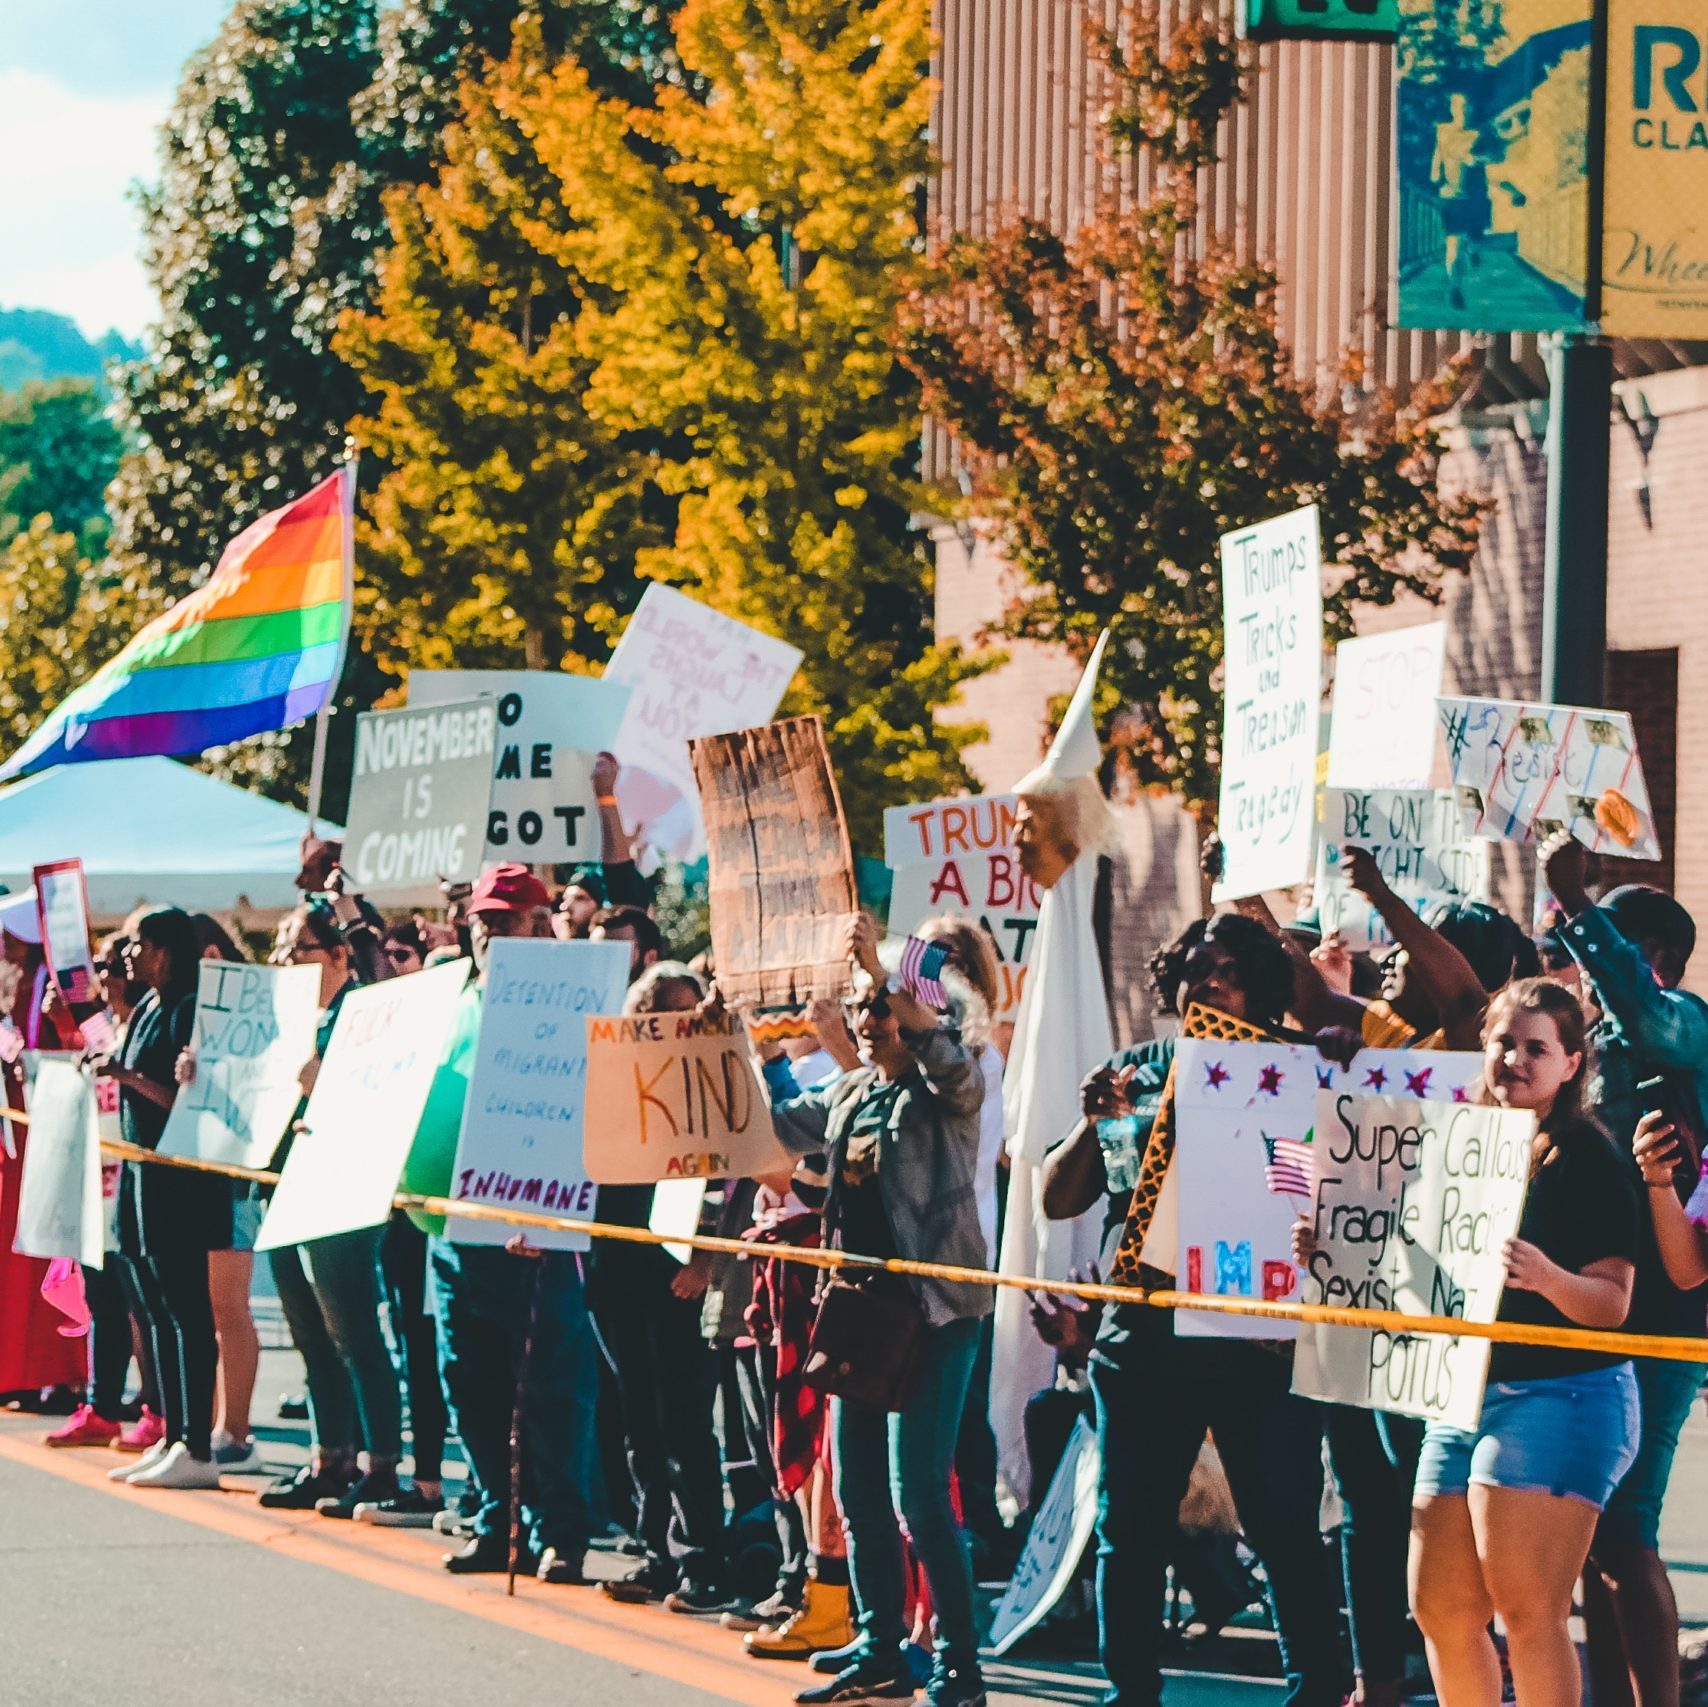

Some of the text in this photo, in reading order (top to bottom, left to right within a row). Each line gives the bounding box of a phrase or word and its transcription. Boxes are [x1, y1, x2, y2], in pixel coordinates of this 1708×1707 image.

[1353, 644, 1435, 720] STOP
[356, 705, 494, 777] NOVEMBER
[402, 773, 433, 820] IS
[1343, 792, 1372, 838] BE
[1388, 794, 1423, 842] ON
[486, 805, 586, 847] GOT
[356, 822, 468, 886] COMING
[929, 860, 970, 907] A
[489, 961, 609, 1014] DETENTION
[590, 1016, 664, 1043] MAKE
[634, 1049, 750, 1145] KIND
[666, 1152, 730, 1176] AGAIN
[1329, 1093, 1438, 1191] Super
[456, 1167, 594, 1212] INHUMANE
[1313, 1178, 1420, 1268] Fragile
[1301, 1249, 1400, 1312] Sexist
